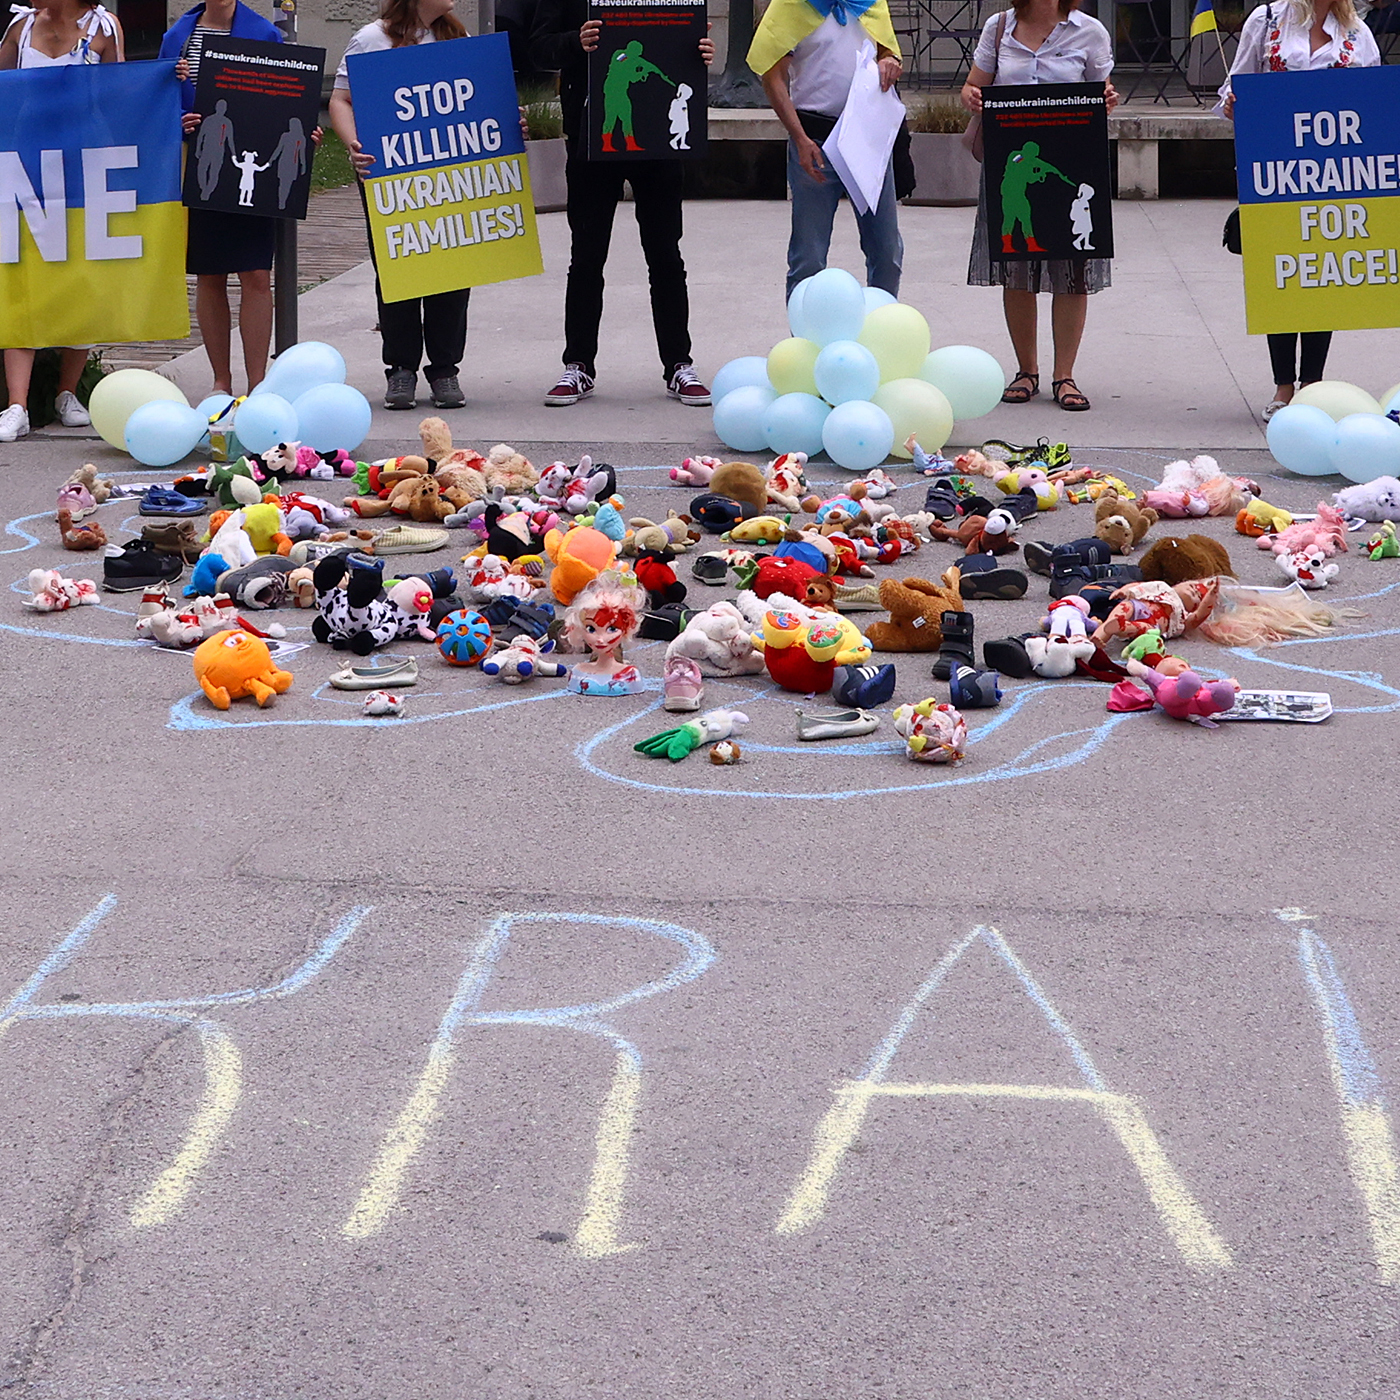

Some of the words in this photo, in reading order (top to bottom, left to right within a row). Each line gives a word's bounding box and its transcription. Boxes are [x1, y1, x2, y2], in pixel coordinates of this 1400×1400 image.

[204, 49, 319, 72] #saveukrainianchildren
[393, 78, 475, 121] STOP
[984, 95, 1104, 108] #saveukrainianchildren
[381, 118, 501, 169] KILLING
[1293, 110, 1363, 147] FOR
[373, 159, 523, 216] UKRANIAN
[385, 203, 525, 260] FAMILIES!
[1300, 203, 1369, 241] FOR
[1275, 248, 1399, 289] PEACE!
